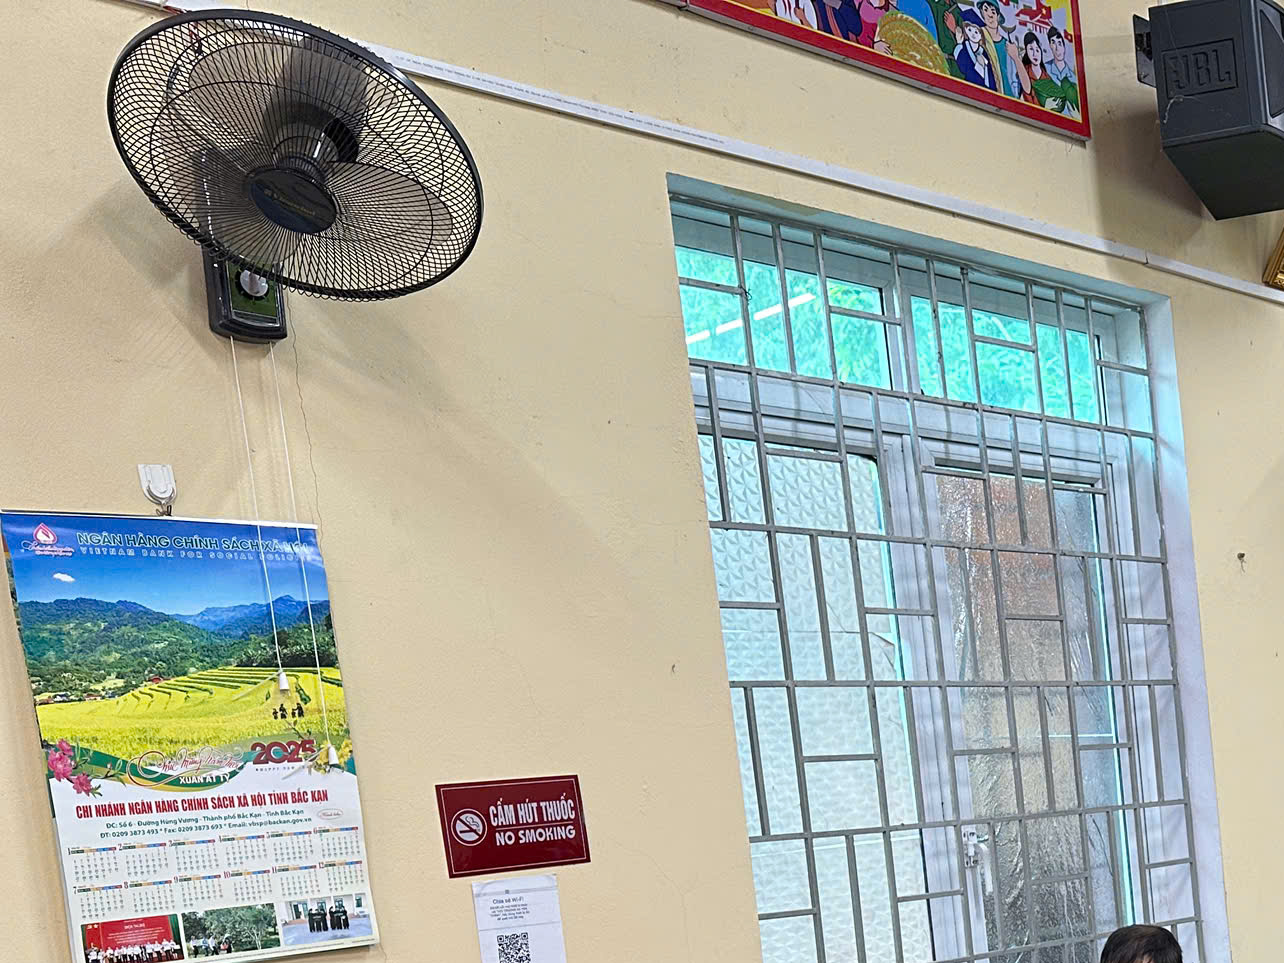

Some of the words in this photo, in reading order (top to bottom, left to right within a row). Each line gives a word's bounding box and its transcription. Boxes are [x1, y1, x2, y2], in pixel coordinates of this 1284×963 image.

[1169, 49, 1231, 89] JBL
[76, 531, 123, 546] NGÂN
[125, 532, 170, 549] HÀNG
[172, 534, 219, 550] CHÍNH
[222, 536, 260, 551] SÁCH
[262, 539, 281, 552] XÃ
[80, 546, 136, 557] VIETNAM
[142, 548, 174, 558] BANK
[180, 550, 203, 559] FOR
[209, 552, 254, 561] SOCIAL
[251, 739, 317, 765] 2025
[75, 805, 93, 819] CHI
[94, 801, 127, 817] NHÁNH
[128, 799, 153, 816] NGÂN
[154, 797, 179, 813] HÀNG
[181, 795, 209, 812] CHÍNH
[211, 793, 235, 810] SÁCH
[236, 793, 249, 808] XÃ
[250, 791, 266, 809] HỘI
[268, 789, 289, 806] TỈNH
[291, 787, 309, 804] BẮC
[311, 789, 329, 805] KẠN
[489, 798, 516, 827] CẤM
[517, 799, 539, 824] HÚT
[540, 792, 576, 821] THUỐC
[111, 830, 129, 838] 0209
[129, 829, 146, 837] 3873
[146, 828, 159, 836] 493
[228, 821, 248, 829] Email:
[137, 819, 160, 828] Đường
[160, 818, 178, 827] Hùng
[178, 816, 199, 825] Vương
[495, 831, 516, 846] NO
[518, 825, 576, 844] SMOKING
